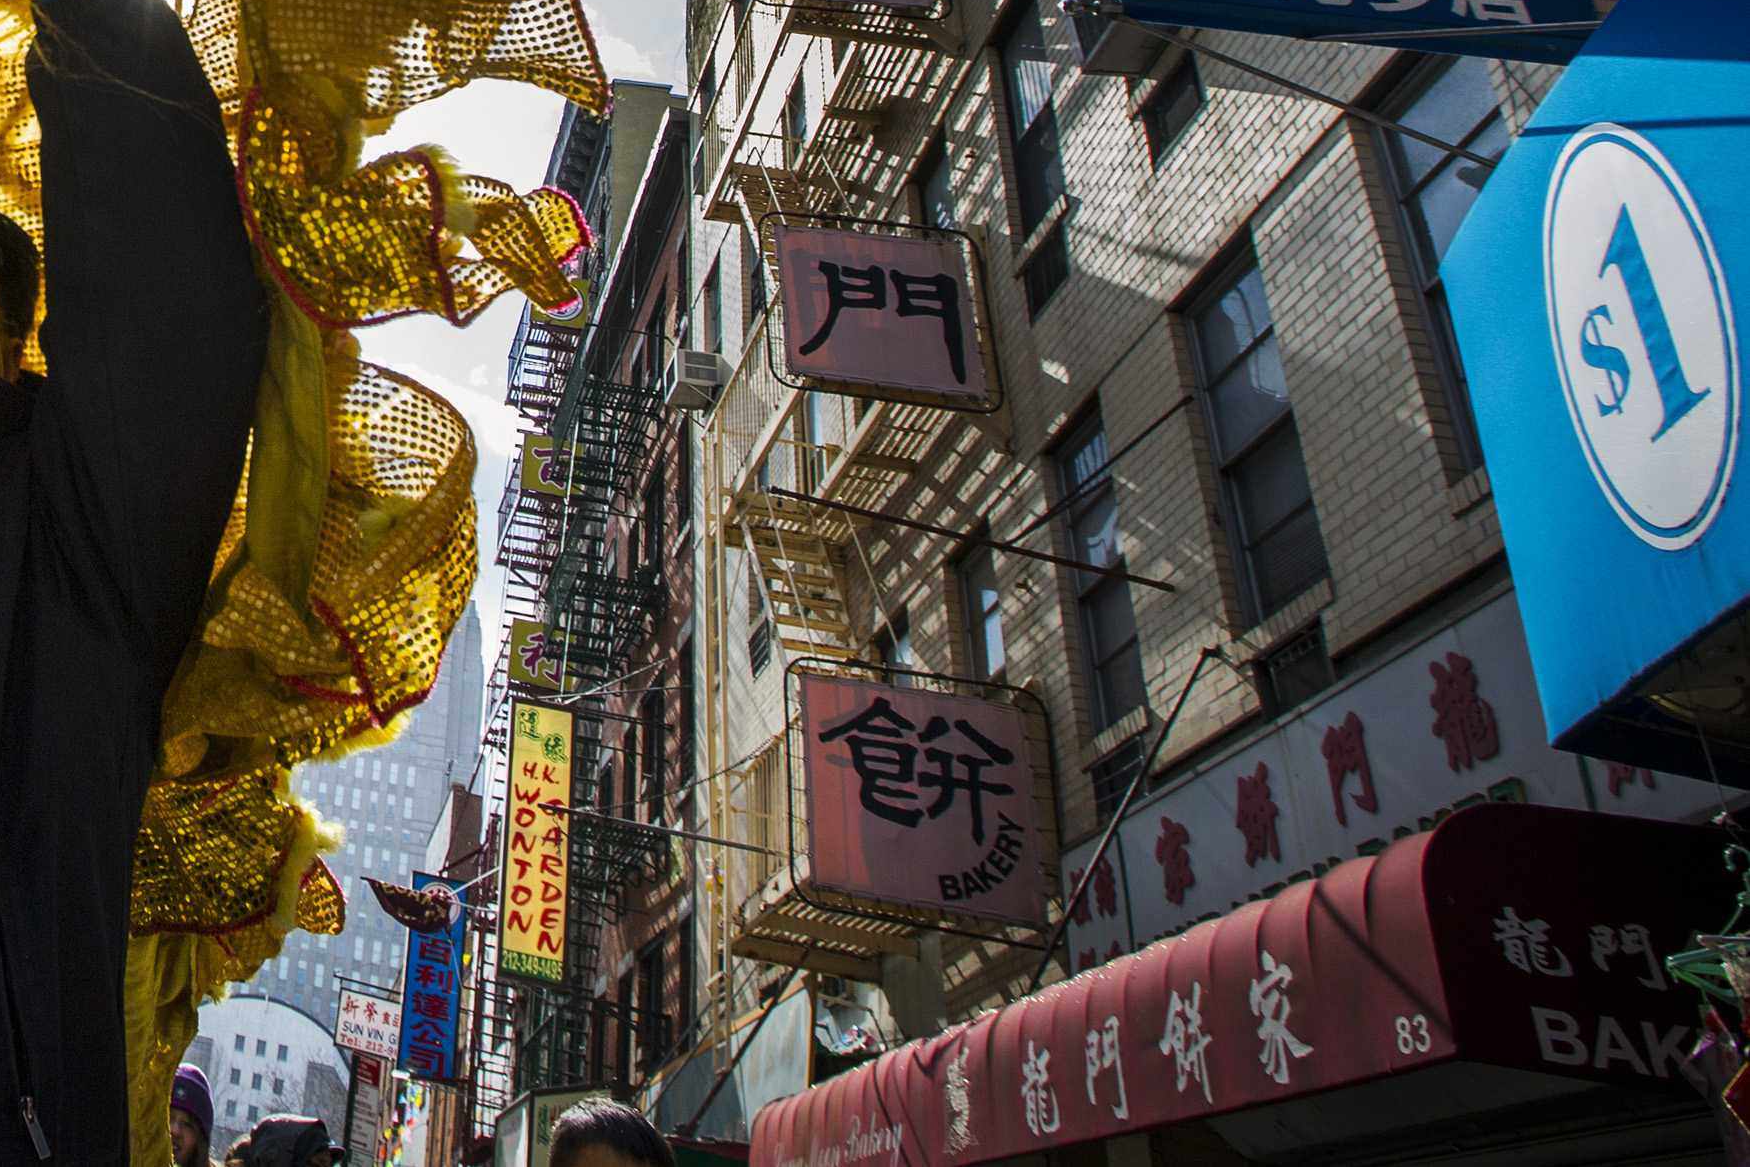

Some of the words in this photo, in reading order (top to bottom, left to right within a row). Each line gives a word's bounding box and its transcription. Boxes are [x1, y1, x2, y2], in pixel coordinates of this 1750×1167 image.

[799, 261, 967, 385] 門
[1578, 202, 1712, 443] $1
[522, 762, 560, 785] H.K.
[819, 697, 1014, 846] 餅
[507, 783, 540, 935] WONTON
[536, 798, 565, 955] GARDEN
[939, 812, 1026, 906] BAKERY
[501, 950, 564, 982] 212-349-1495
[339, 1033, 362, 1049] Tel:
[341, 1021, 364, 1036] SUN
[366, 1025, 384, 1042] VIN
[1020, 948, 1313, 1138] 龍門餅家
[1394, 1014, 1432, 1055] 83
[1531, 1005, 1710, 1082] BAK
